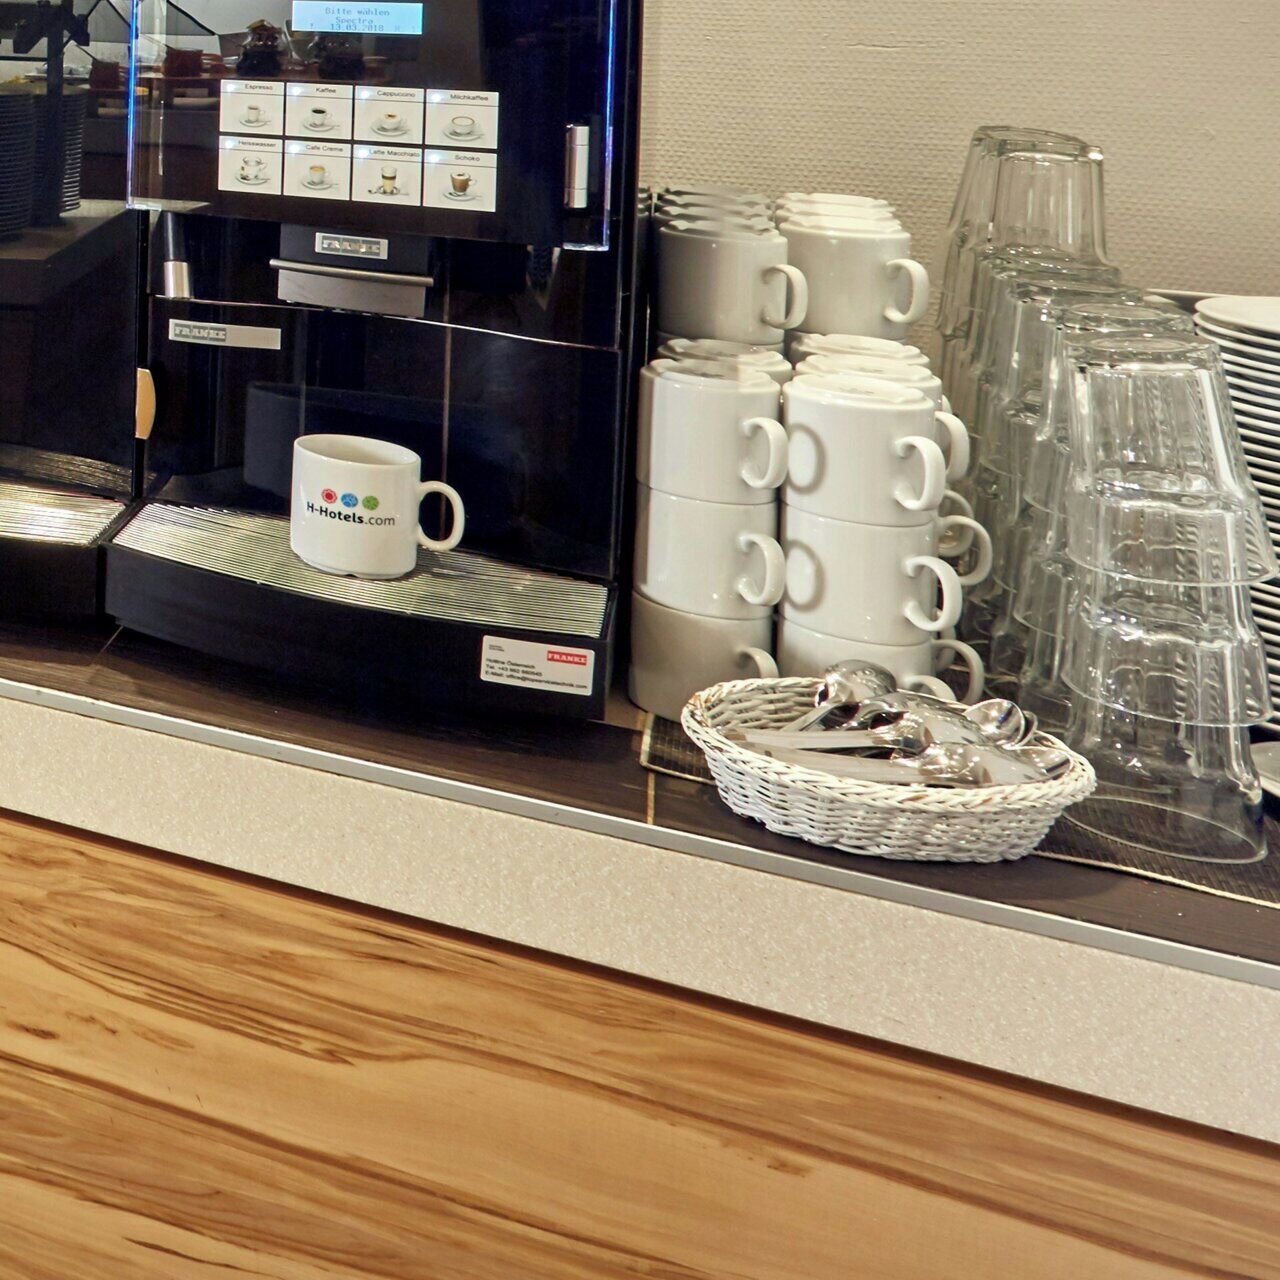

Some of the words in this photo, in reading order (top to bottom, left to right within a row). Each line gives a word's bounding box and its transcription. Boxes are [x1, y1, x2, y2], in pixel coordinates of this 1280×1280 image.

[325, 7, 352, 15] Bitte
[357, 8, 390, 16] wählen
[244, 84, 274, 92] Espresso
[376, 90, 416, 99] Cappuccino
[450, 93, 489, 102] Milchkaffee
[368, 148, 385, 156] Latte
[386, 150, 420, 158] Macchiato
[454, 154, 481, 162] Schoko
[174, 326, 227, 339] FRANKE
[306, 501, 396, 526] H-Hotels.com
[547, 652, 587, 663] FRANKE
